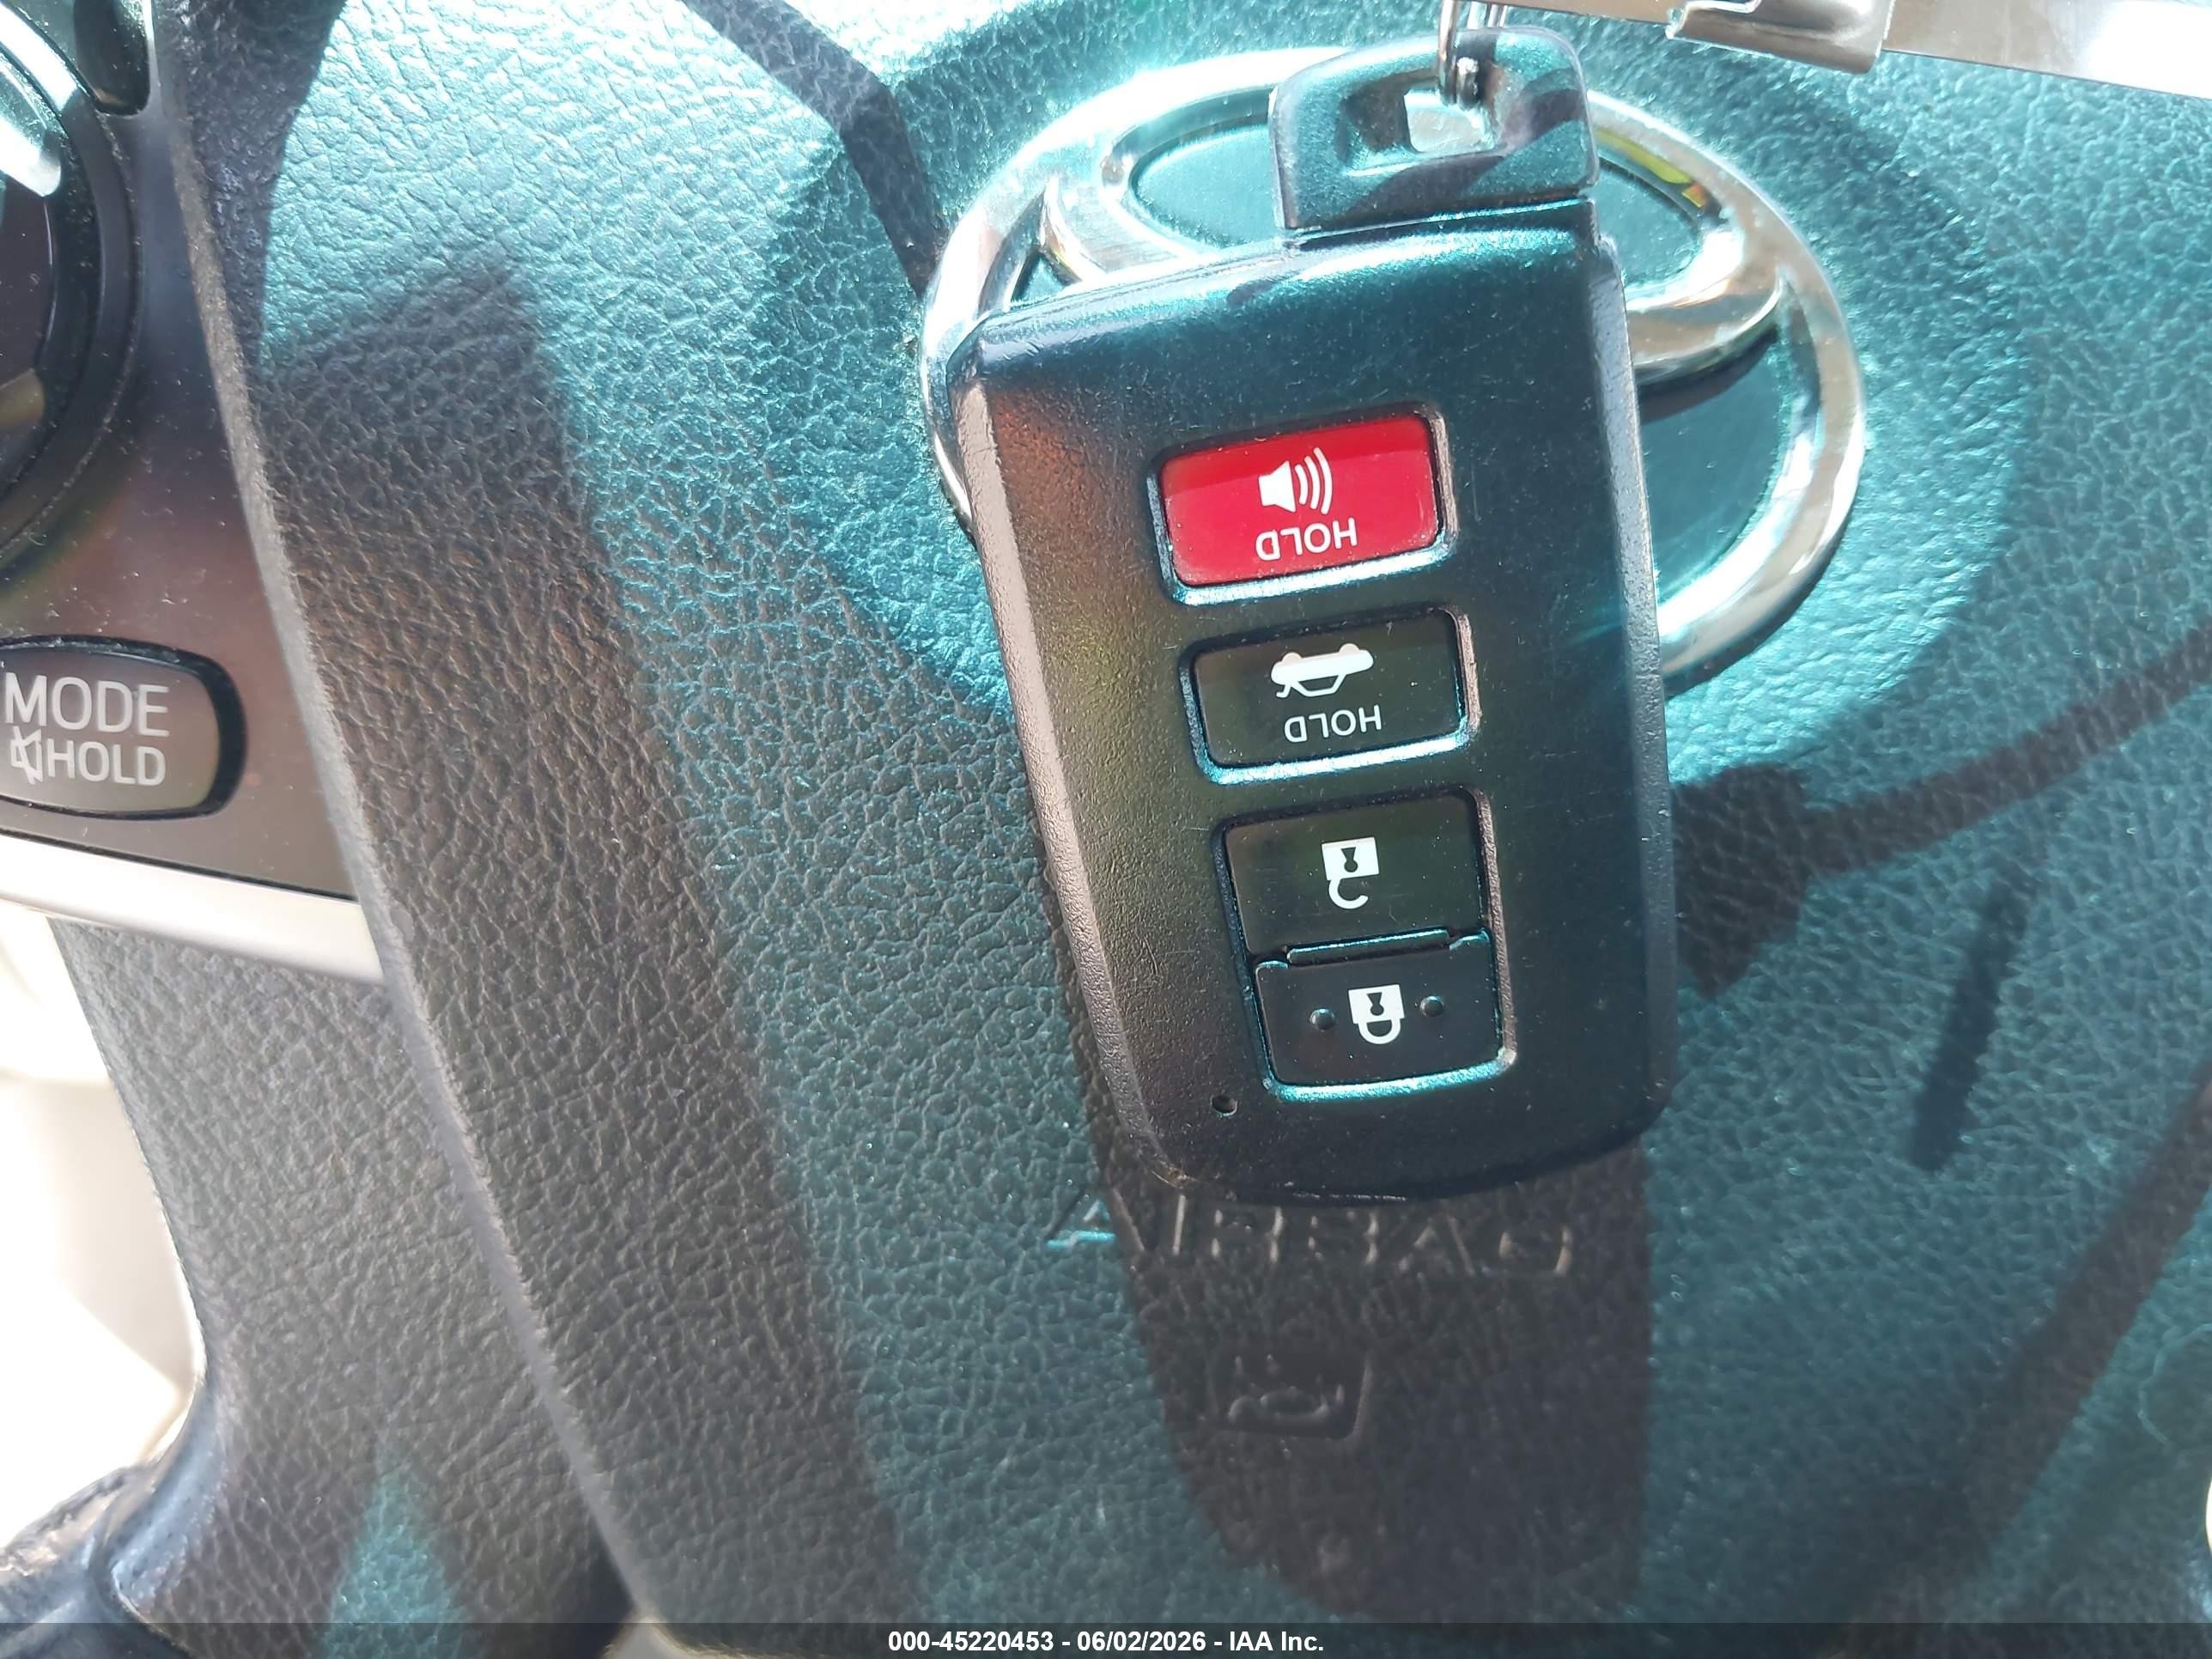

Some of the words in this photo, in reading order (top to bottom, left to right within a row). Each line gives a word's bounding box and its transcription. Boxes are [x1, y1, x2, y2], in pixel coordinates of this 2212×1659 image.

[1255, 517, 1358, 561] HOLD
[4, 672, 170, 738] MODE
[1283, 704, 1382, 743] HOLD
[46, 738, 167, 786] HOLD
